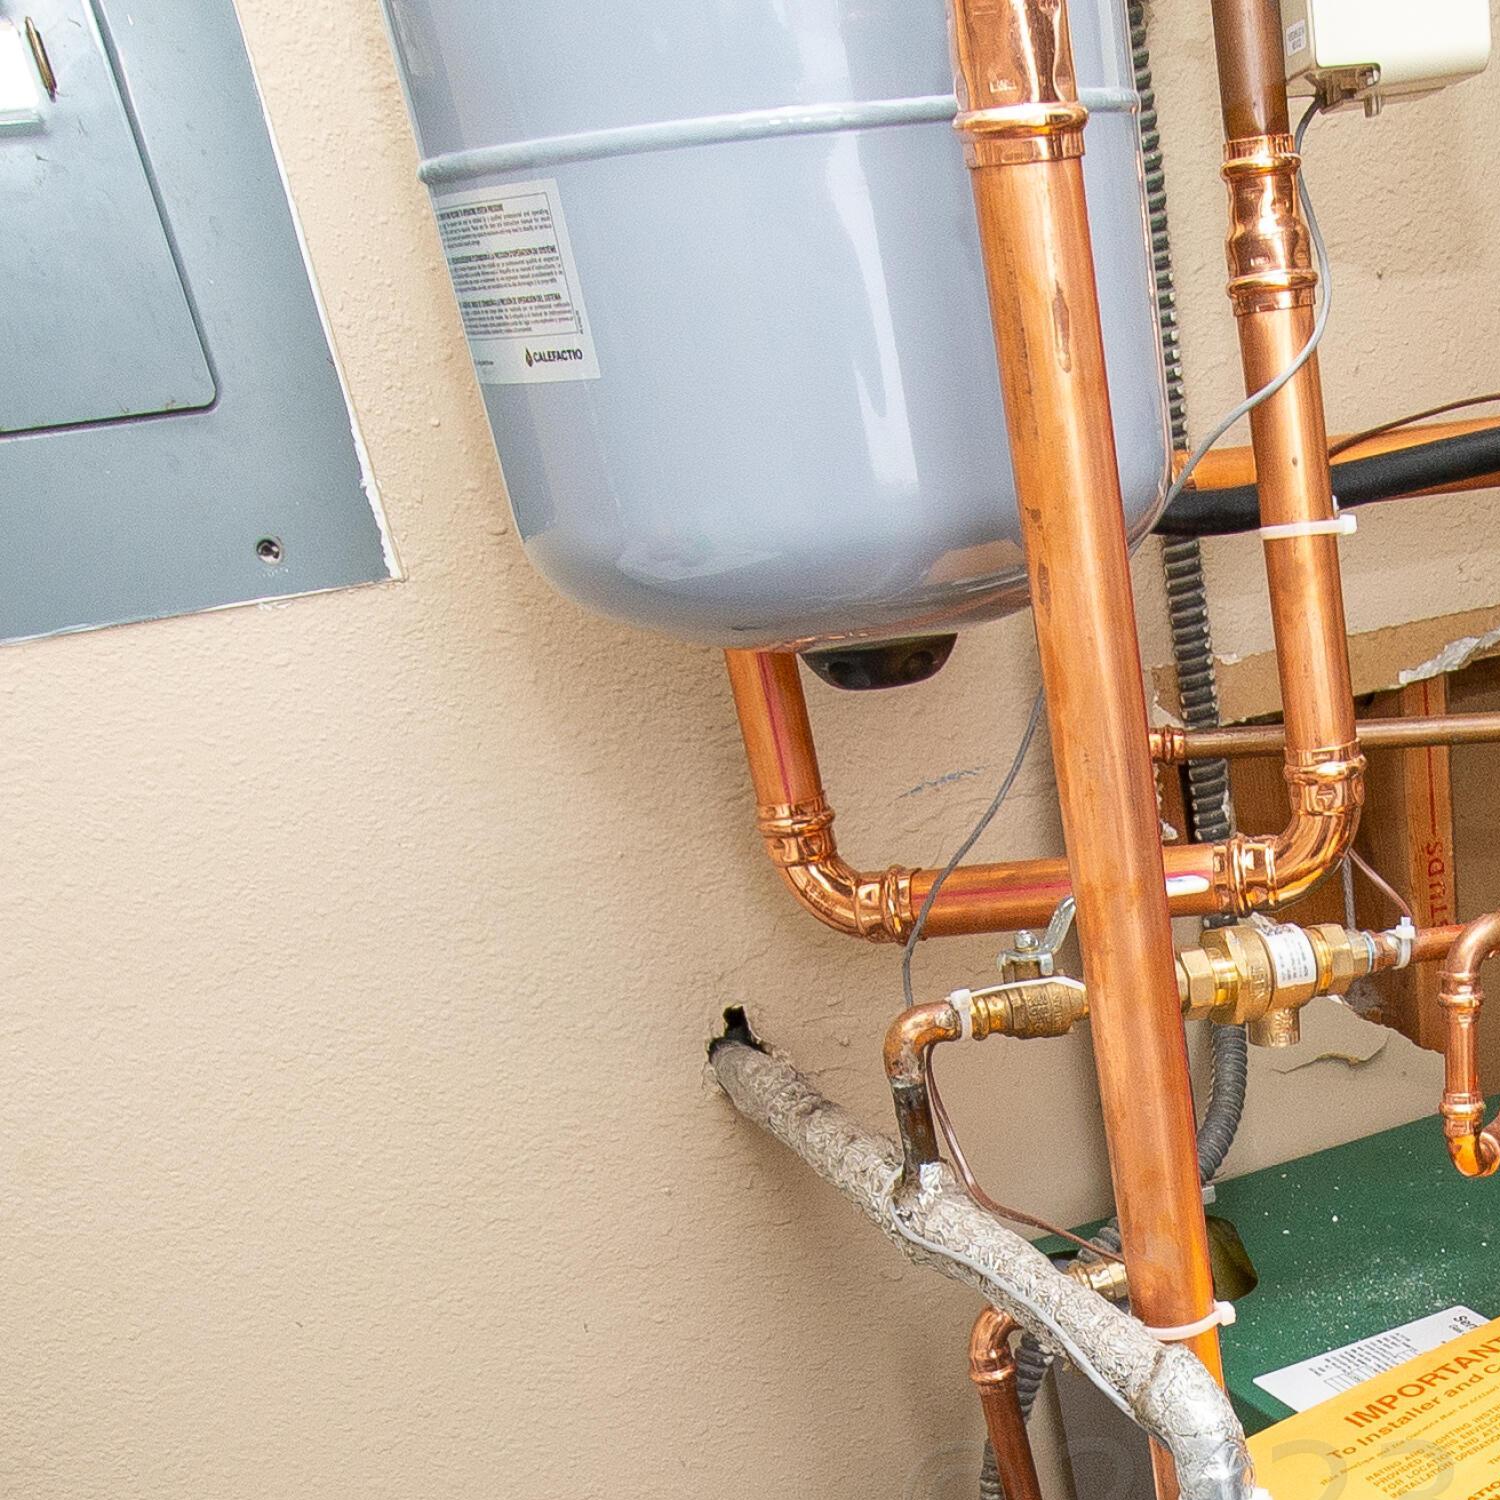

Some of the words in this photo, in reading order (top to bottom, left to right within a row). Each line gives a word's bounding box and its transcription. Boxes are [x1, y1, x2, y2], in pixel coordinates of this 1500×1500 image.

[533, 348, 583, 363] CALEFACTIO
[1326, 1442, 1358, 1462] To
[1355, 1394, 1443, 1447] Installer
[1439, 1372, 1484, 1397] and
[1363, 1459, 1403, 1482] RATING
[1402, 1447, 1426, 1461] AND
[1424, 1421, 1473, 1449] LIGHTING
[1371, 1457, 1424, 1487] PROVIDED
[1435, 1437, 1460, 1452] THIS
[1380, 1476, 1407, 1493] FOR
[1404, 1449, 1457, 1479] LOCATION
[1456, 1436, 1480, 1450] AND
